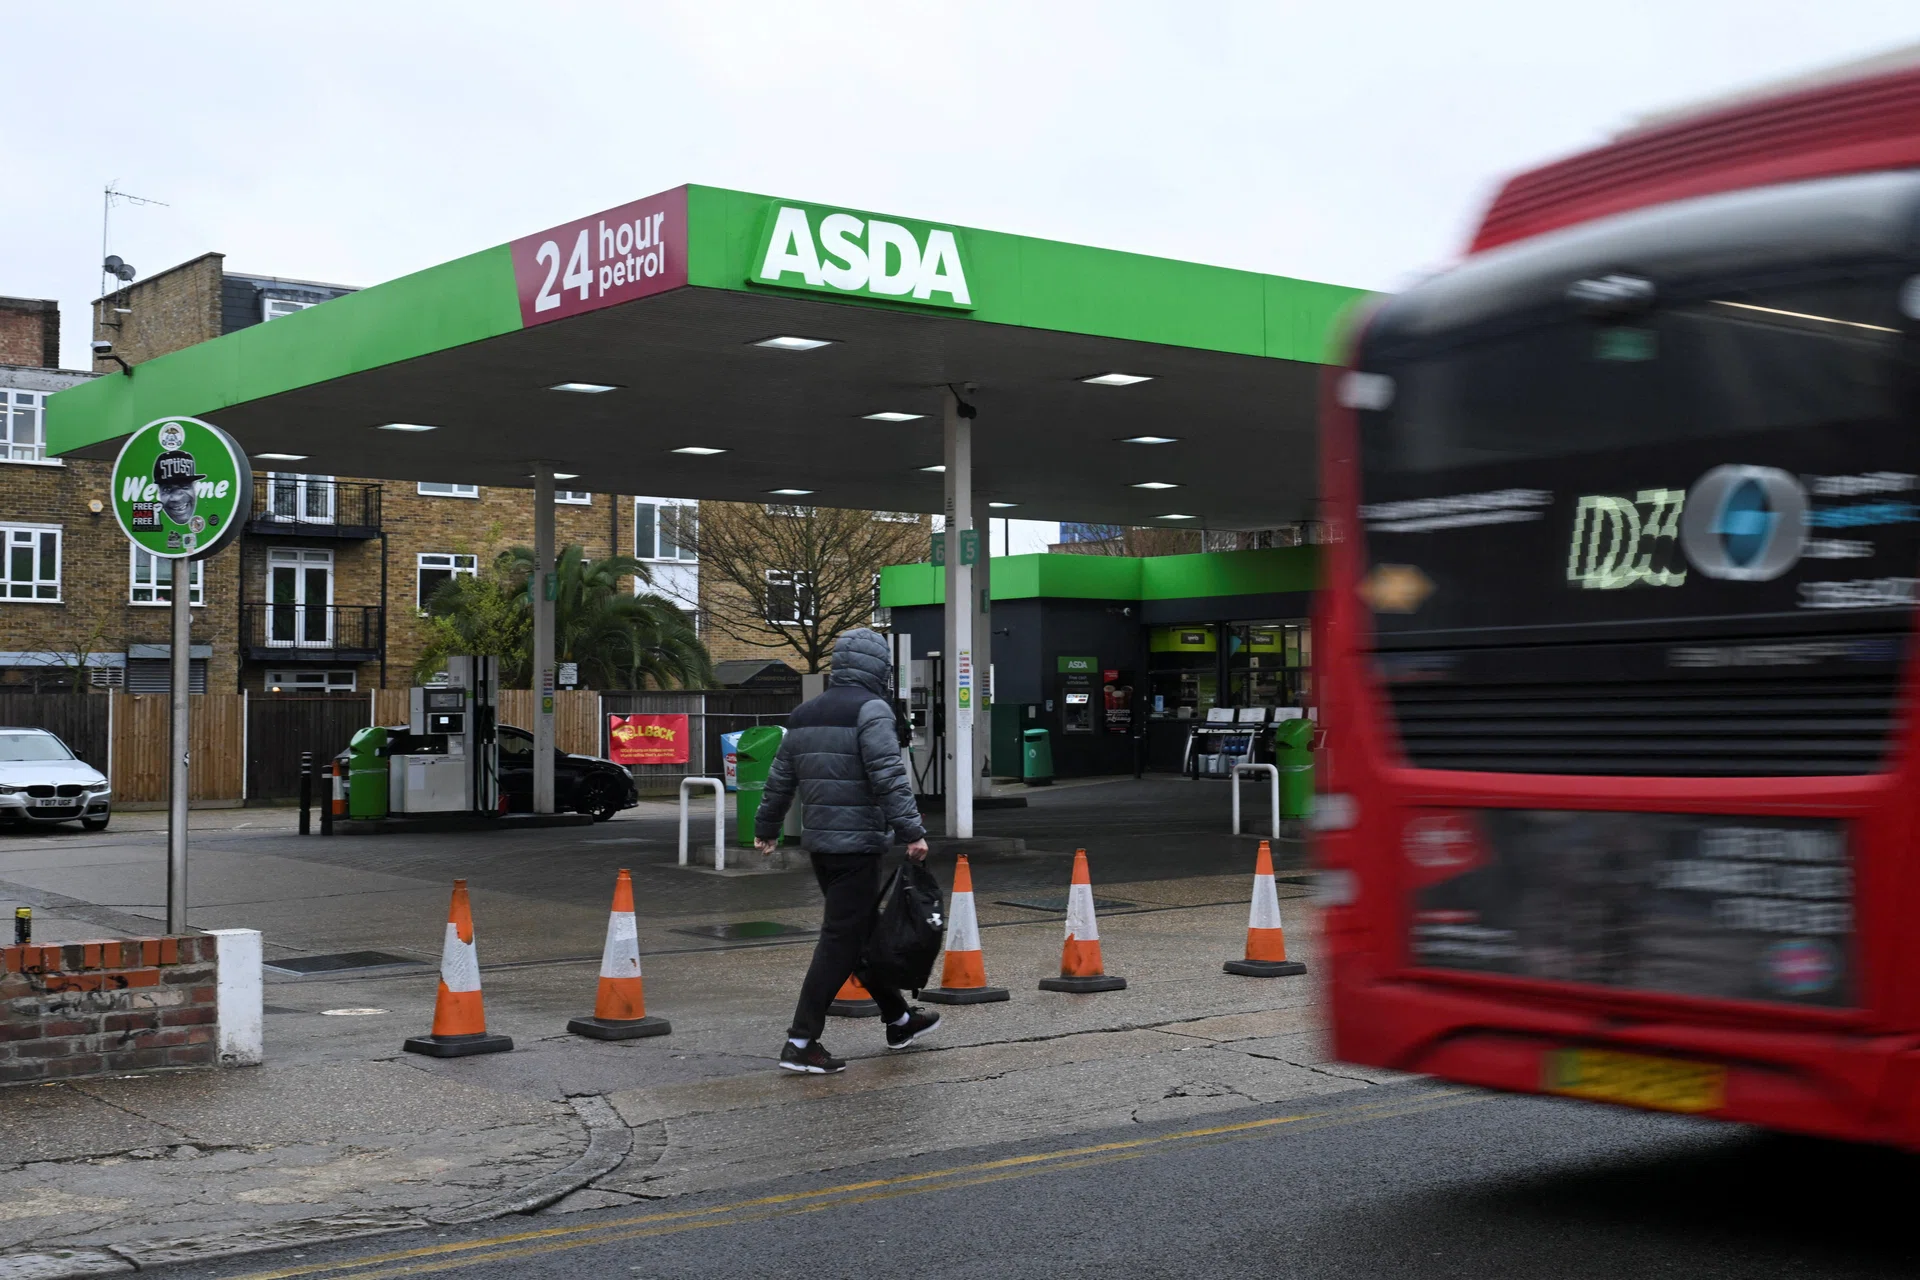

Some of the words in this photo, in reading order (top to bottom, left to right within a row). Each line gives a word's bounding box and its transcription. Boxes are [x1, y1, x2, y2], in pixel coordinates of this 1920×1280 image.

[534, 229, 594, 313] 24
[599, 211, 665, 262] hour
[759, 206, 972, 305] ASDA
[599, 241, 665, 297] petrol
[122, 475, 230, 502] Weme
[132, 502, 153, 511] FREE
[132, 517, 153, 525] FREE
[965, 541, 975, 560] 5
[1068, 661, 1088, 669] ASDA
